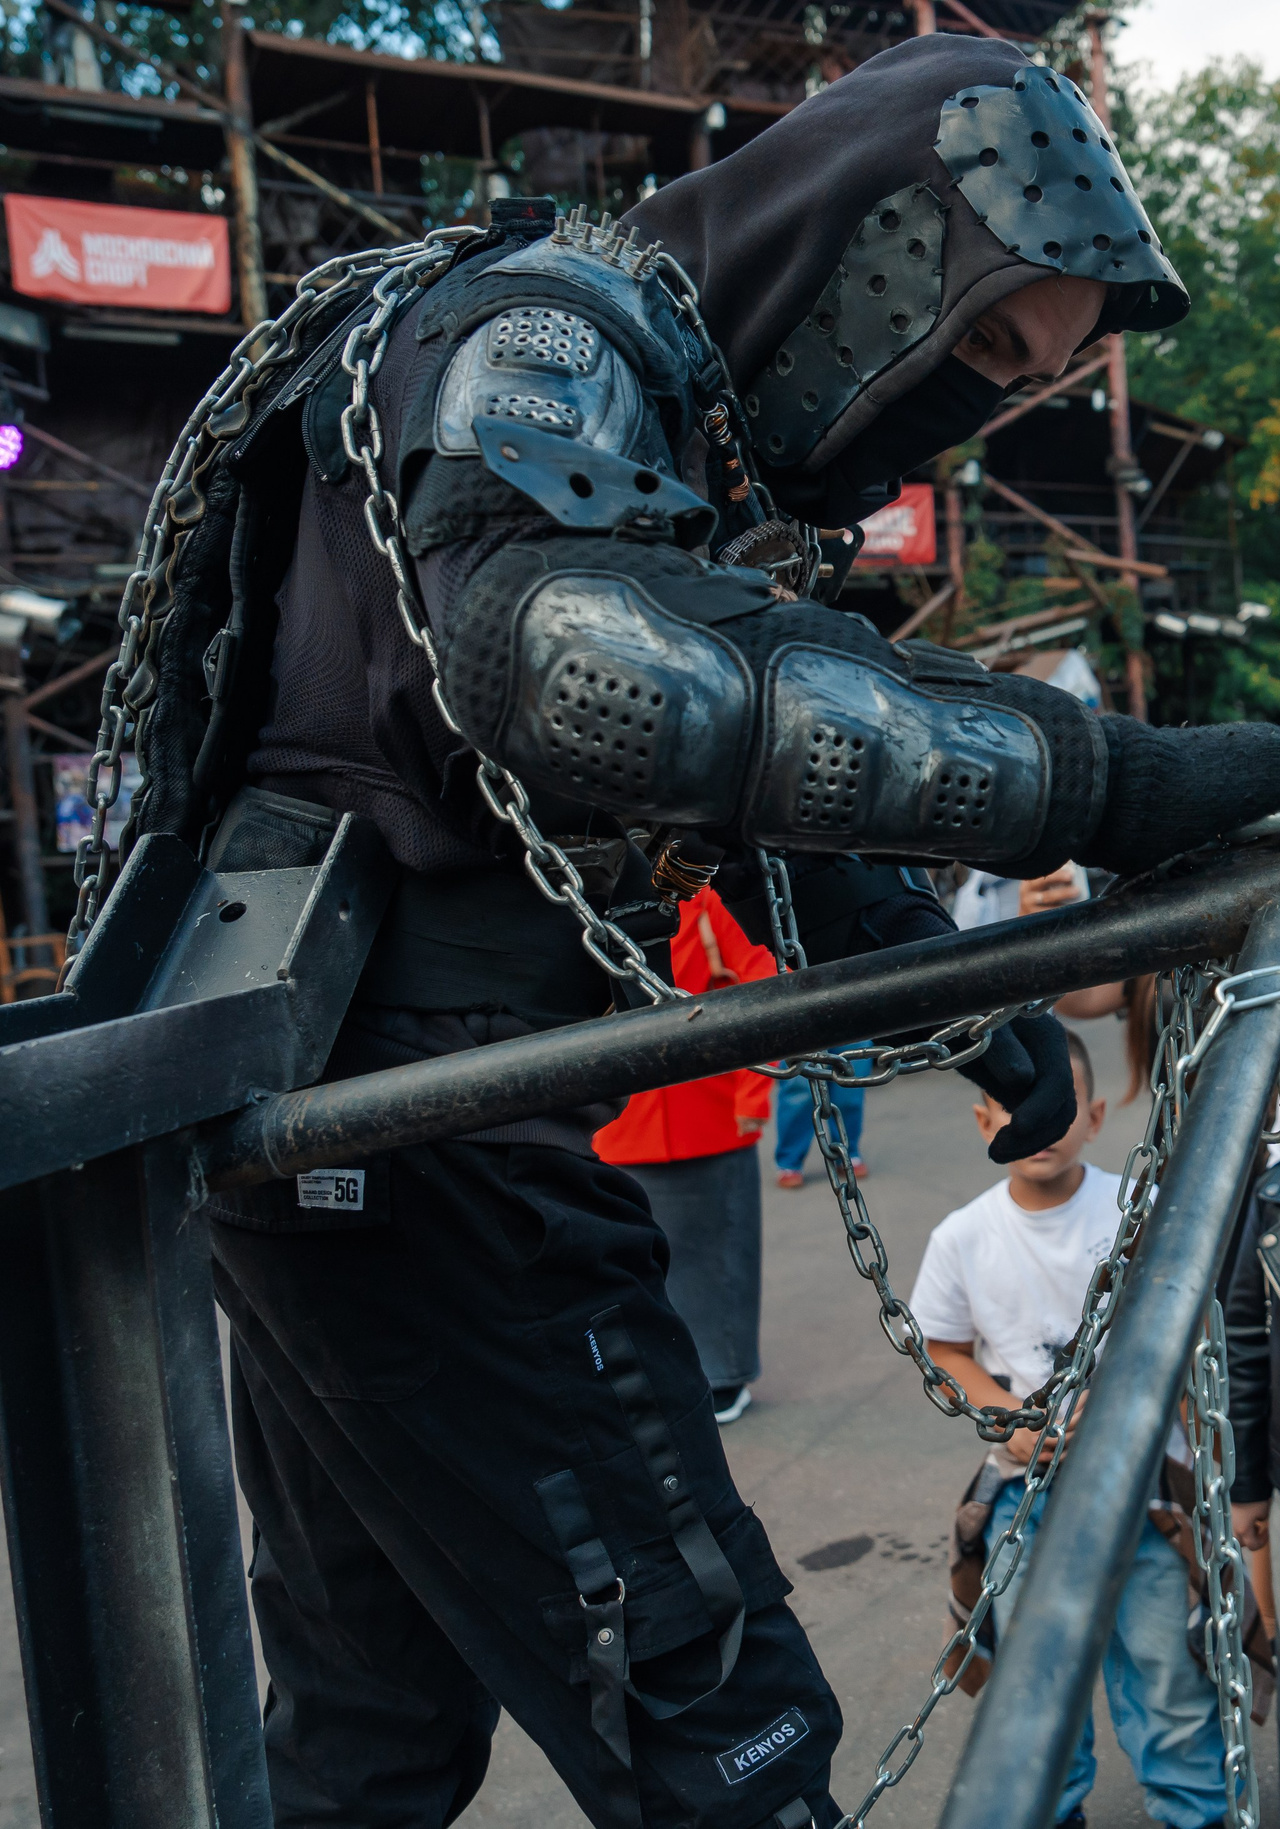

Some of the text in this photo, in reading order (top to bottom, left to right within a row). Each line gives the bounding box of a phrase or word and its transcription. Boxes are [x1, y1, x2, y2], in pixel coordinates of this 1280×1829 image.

[334, 1177, 358, 1203] 5G
[589, 1333, 604, 1371] KENYOS
[734, 1723, 796, 1771] KENYOS
